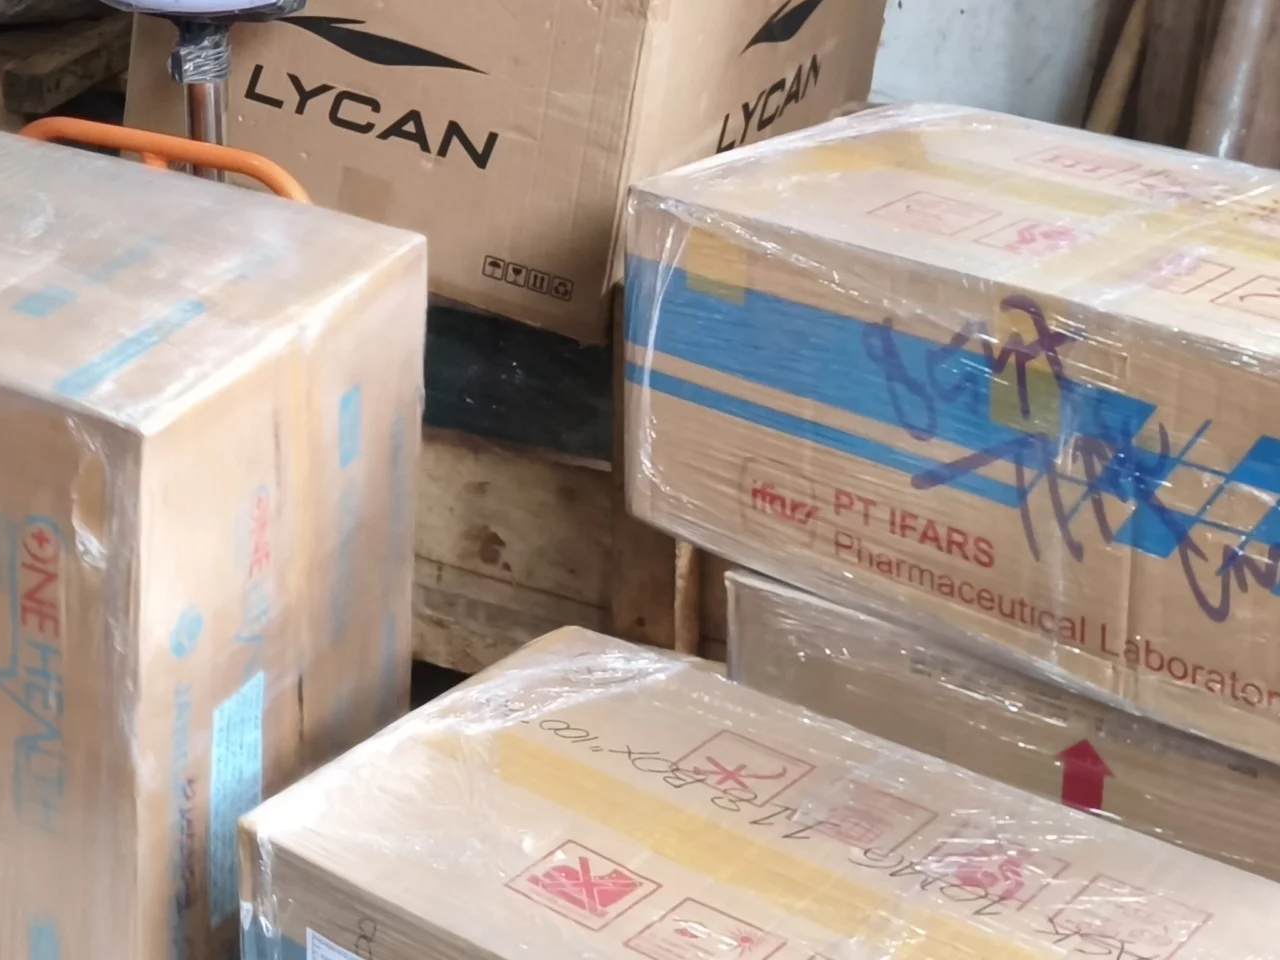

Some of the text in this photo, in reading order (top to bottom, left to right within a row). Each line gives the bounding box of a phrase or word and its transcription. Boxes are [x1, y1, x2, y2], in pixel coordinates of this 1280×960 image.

[244, 64, 499, 170] LYCAN
[715, 52, 822, 155] LYCAN
[832, 488, 997, 570] PT IFARS
[833, 530, 1088, 646] Pharmaceutical
